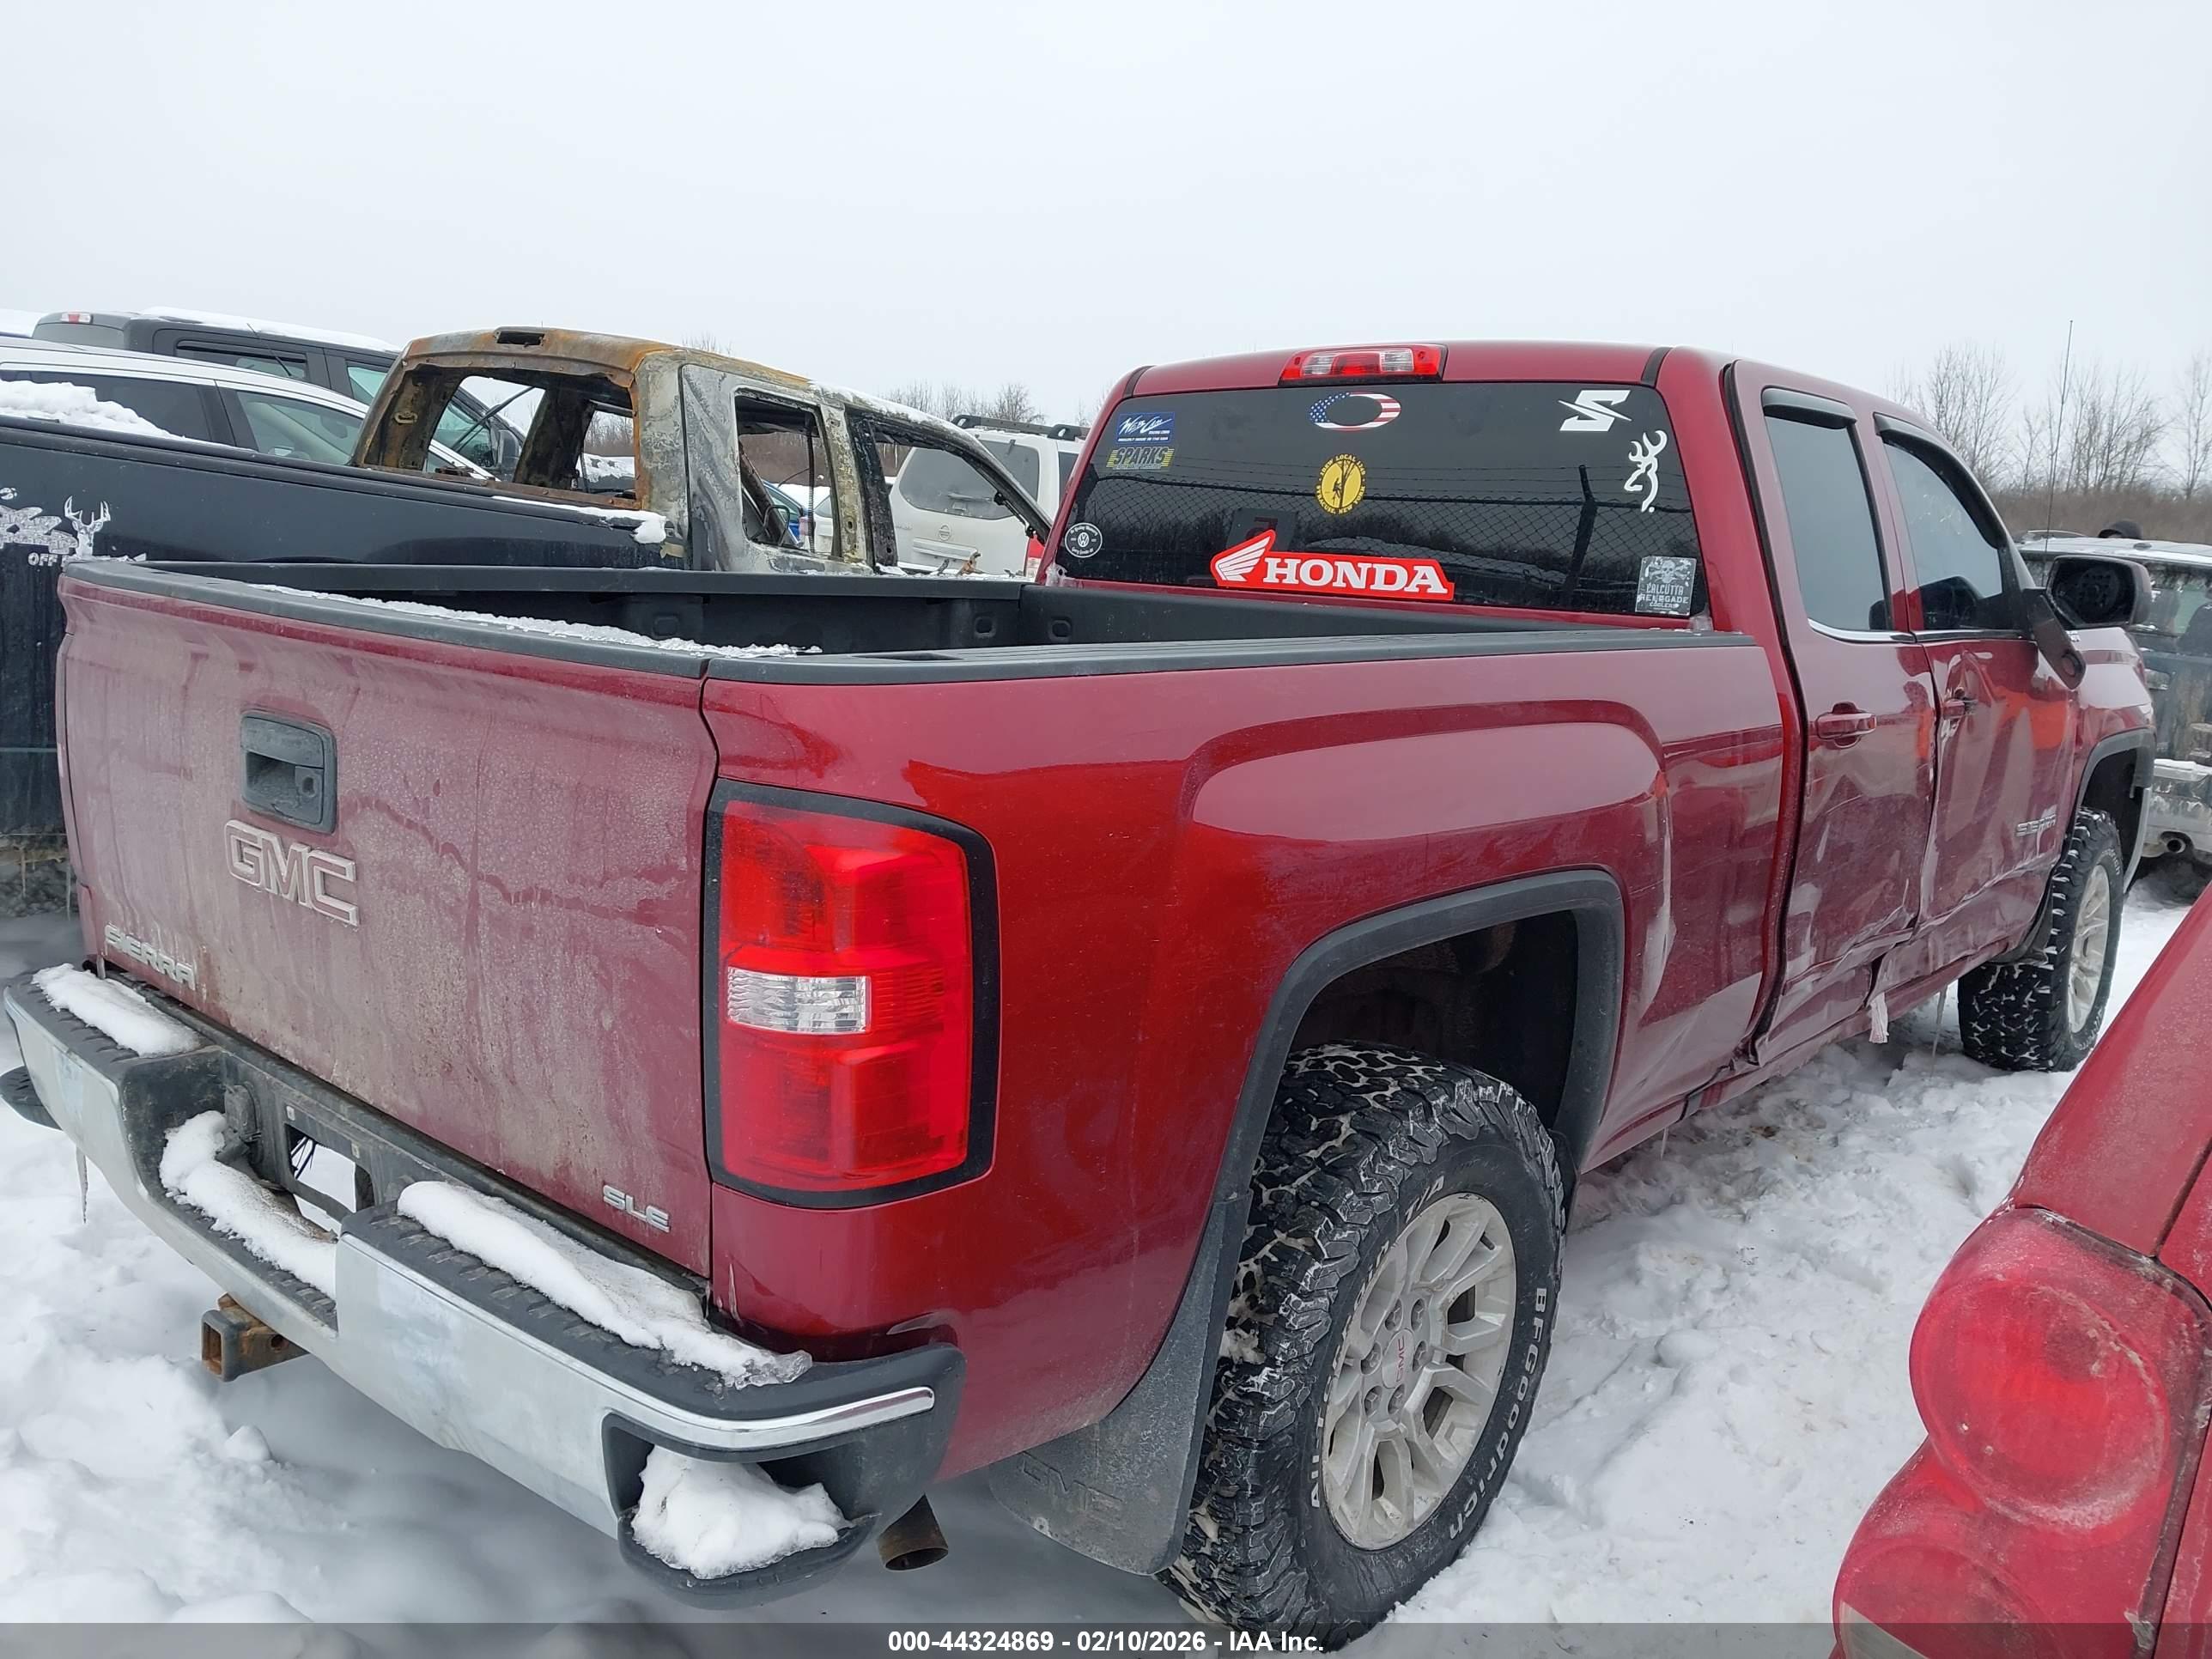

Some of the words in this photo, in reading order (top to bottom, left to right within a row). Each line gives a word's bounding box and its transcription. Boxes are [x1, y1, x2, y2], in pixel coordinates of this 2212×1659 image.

[1113, 447, 1169, 465] SPARKS
[1335, 454, 1357, 463] LOCAL
[27, 552, 58, 567] OFF
[1263, 557, 1449, 594] HONDA
[1646, 581, 1684, 596] CALCUTTA
[225, 818, 359, 927] GMC
[105, 922, 197, 991] SIERRA
[603, 1184, 670, 1233] SLE
[1395, 1334, 1405, 1382] GMC
